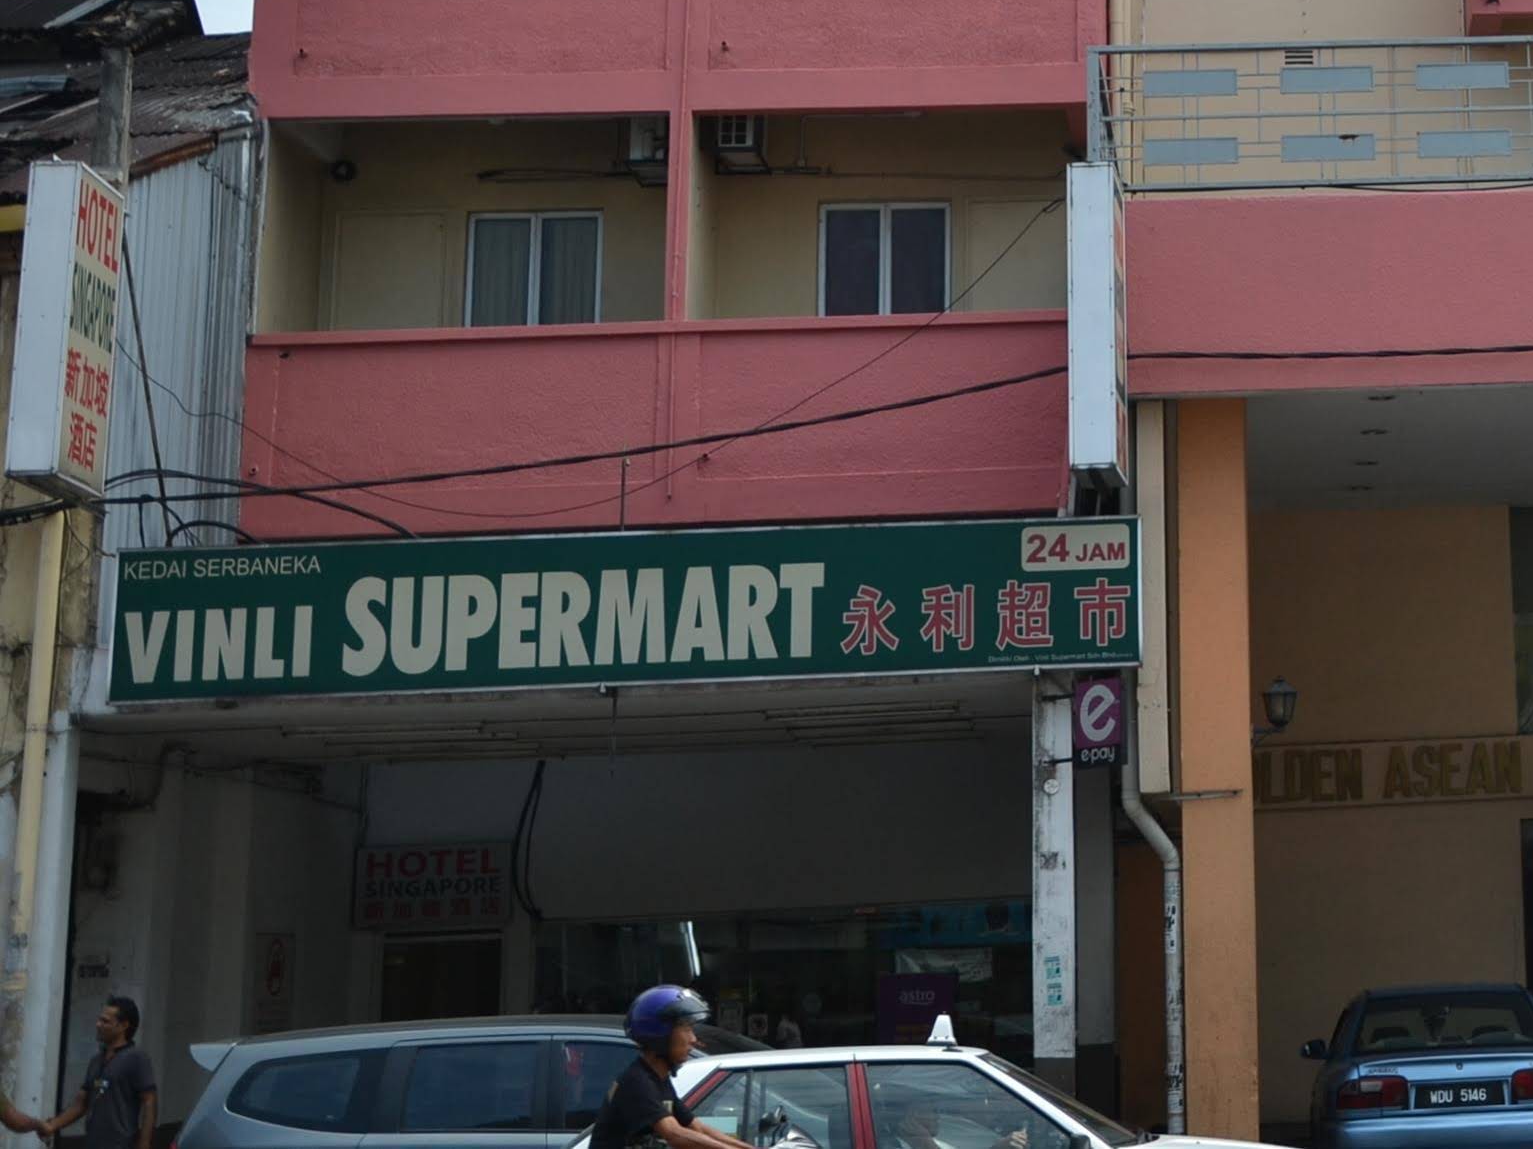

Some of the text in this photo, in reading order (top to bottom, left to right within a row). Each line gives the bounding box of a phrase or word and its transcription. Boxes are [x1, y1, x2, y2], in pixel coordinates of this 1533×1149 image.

[76, 178, 118, 274] HOTEL
[69, 261, 117, 355] SINGAPORE
[64, 347, 110, 419] 新加坡
[67, 410, 98, 474] 酒店
[124, 555, 321, 580] KEDAI SERBANEKA
[1026, 533, 1126, 563] 24 JAM
[124, 562, 825, 684] VINLI SUPERMART
[841, 577, 1131, 655] 永利超市
[1080, 684, 1116, 742] e
[1382, 740, 1523, 799] ASEAN
[365, 876, 501, 898] SINGAPORE
[367, 848, 499, 878] HOTEL
[899, 989, 936, 1005] astro
[1430, 1088, 1487, 1103] WDU 5146
